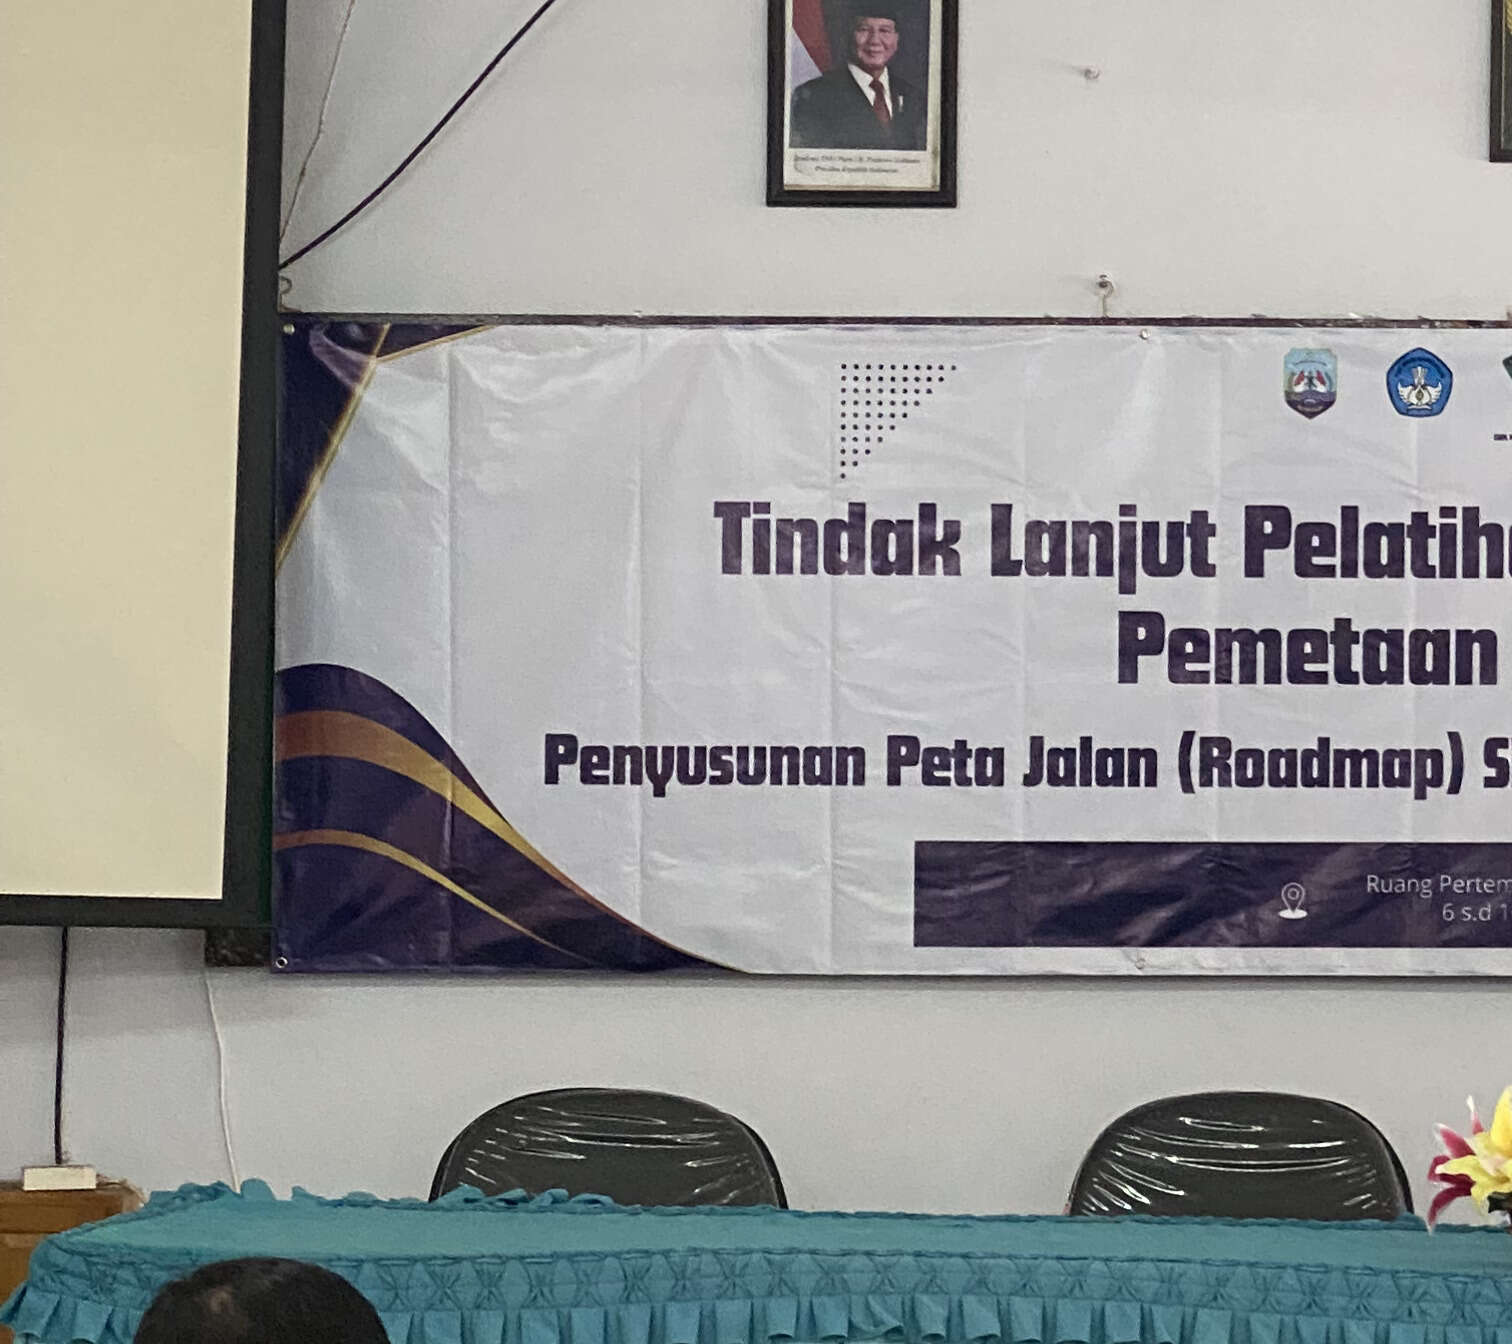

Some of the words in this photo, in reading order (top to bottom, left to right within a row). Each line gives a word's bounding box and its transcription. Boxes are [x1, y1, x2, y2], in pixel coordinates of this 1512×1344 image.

[713, 500, 962, 577] Tindak
[990, 503, 1217, 595] Lanjut
[1117, 610, 1498, 686] Pemetaan
[544, 733, 866, 799] Penyusunan
[886, 734, 1005, 787] Peta
[1021, 735, 1158, 788] Jalan
[1177, 730, 1465, 801] (Roadmap)
[1366, 874, 1433, 898] Ruang
[1442, 903, 1455, 922] 6
[1461, 903, 1491, 922] s.d
